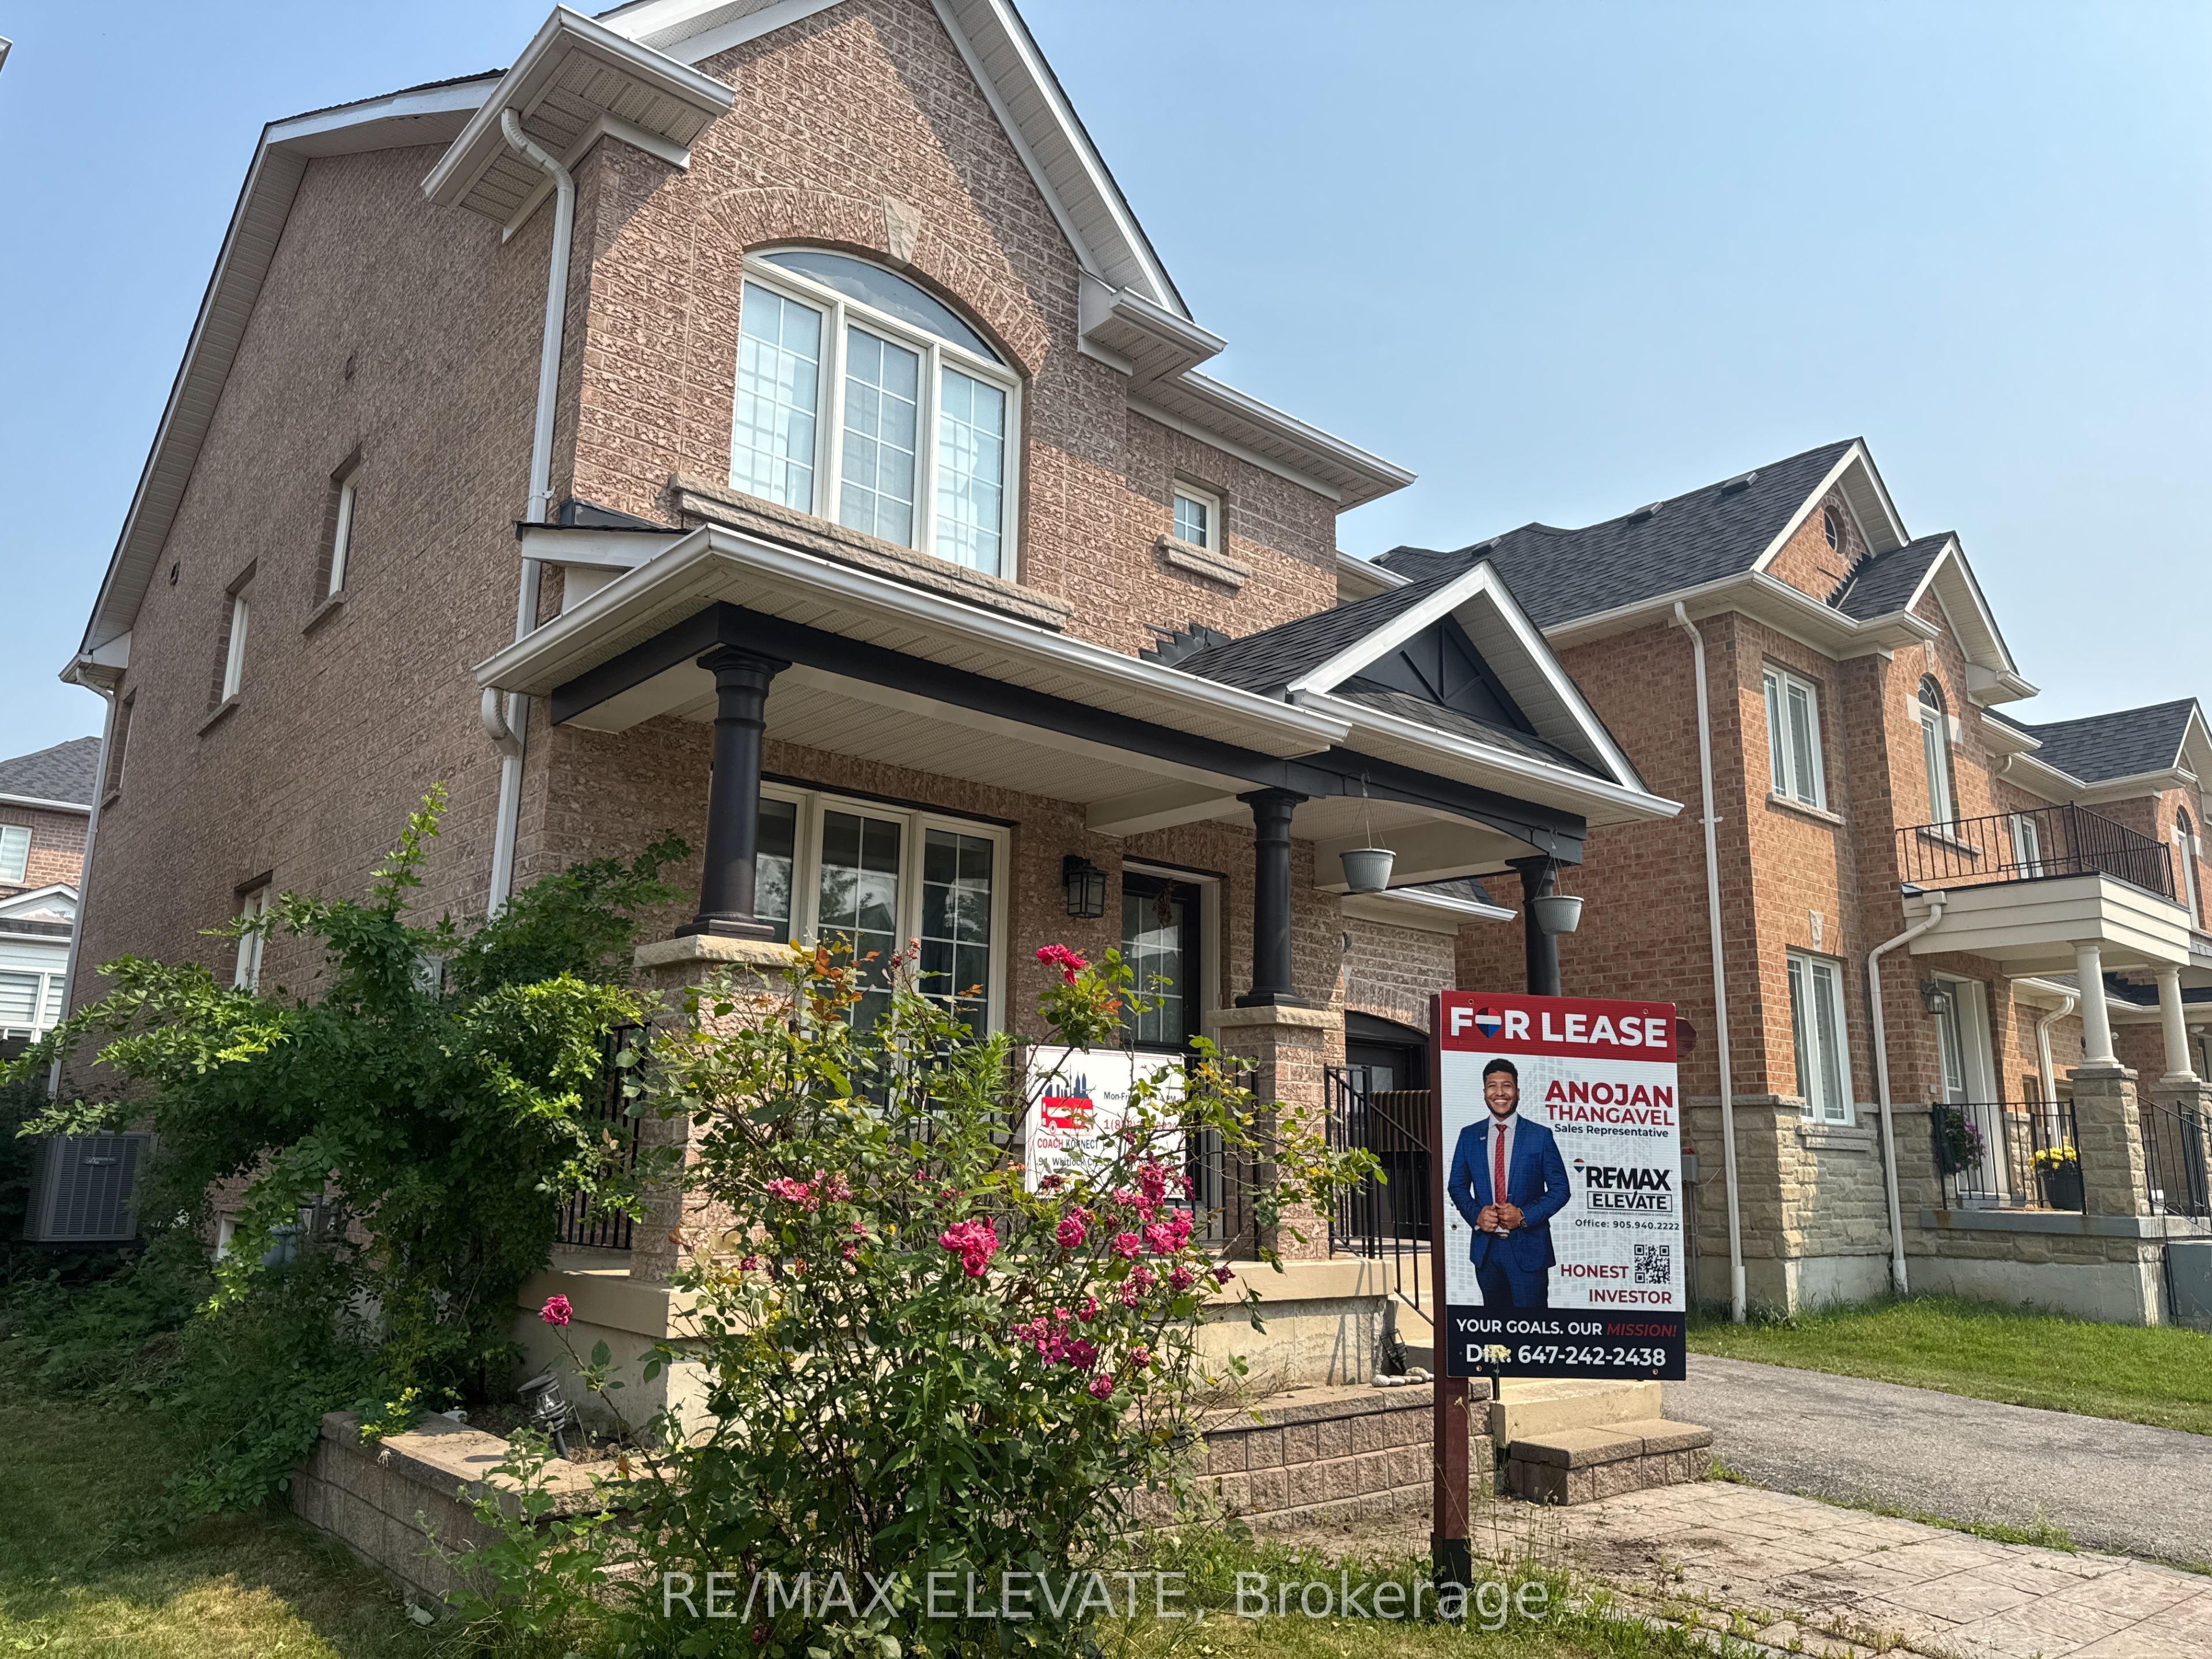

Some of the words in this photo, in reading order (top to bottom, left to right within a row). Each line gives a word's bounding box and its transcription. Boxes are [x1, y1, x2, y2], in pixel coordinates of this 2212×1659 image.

[1541, 1012, 1668, 1047] LEASE
[1544, 1080, 1673, 1108] ANOJAN
[1545, 1104, 1675, 1126] THANGAVEL
[1555, 1123, 1584, 1134] Sales
[1586, 1126, 1669, 1138] Representative
[1037, 1138, 1063, 1149] COACH
[1593, 1192, 1667, 1210] ELEVATE
[1575, 1219, 1609, 1228] Office:
[1613, 1221, 1680, 1230] 905.940.2222
[1560, 1264, 1629, 1279] HONEST
[1589, 1289, 1672, 1304] INVESTOR
[1456, 1319, 1502, 1334] YOUR
[1506, 1320, 1564, 1335] GOALS.
[1568, 1322, 1603, 1336] OUR
[1607, 1323, 1678, 1337] MISSION!
[1466, 1343, 1512, 1363] DI:
[1518, 1345, 1666, 1366] 647-242-2438
